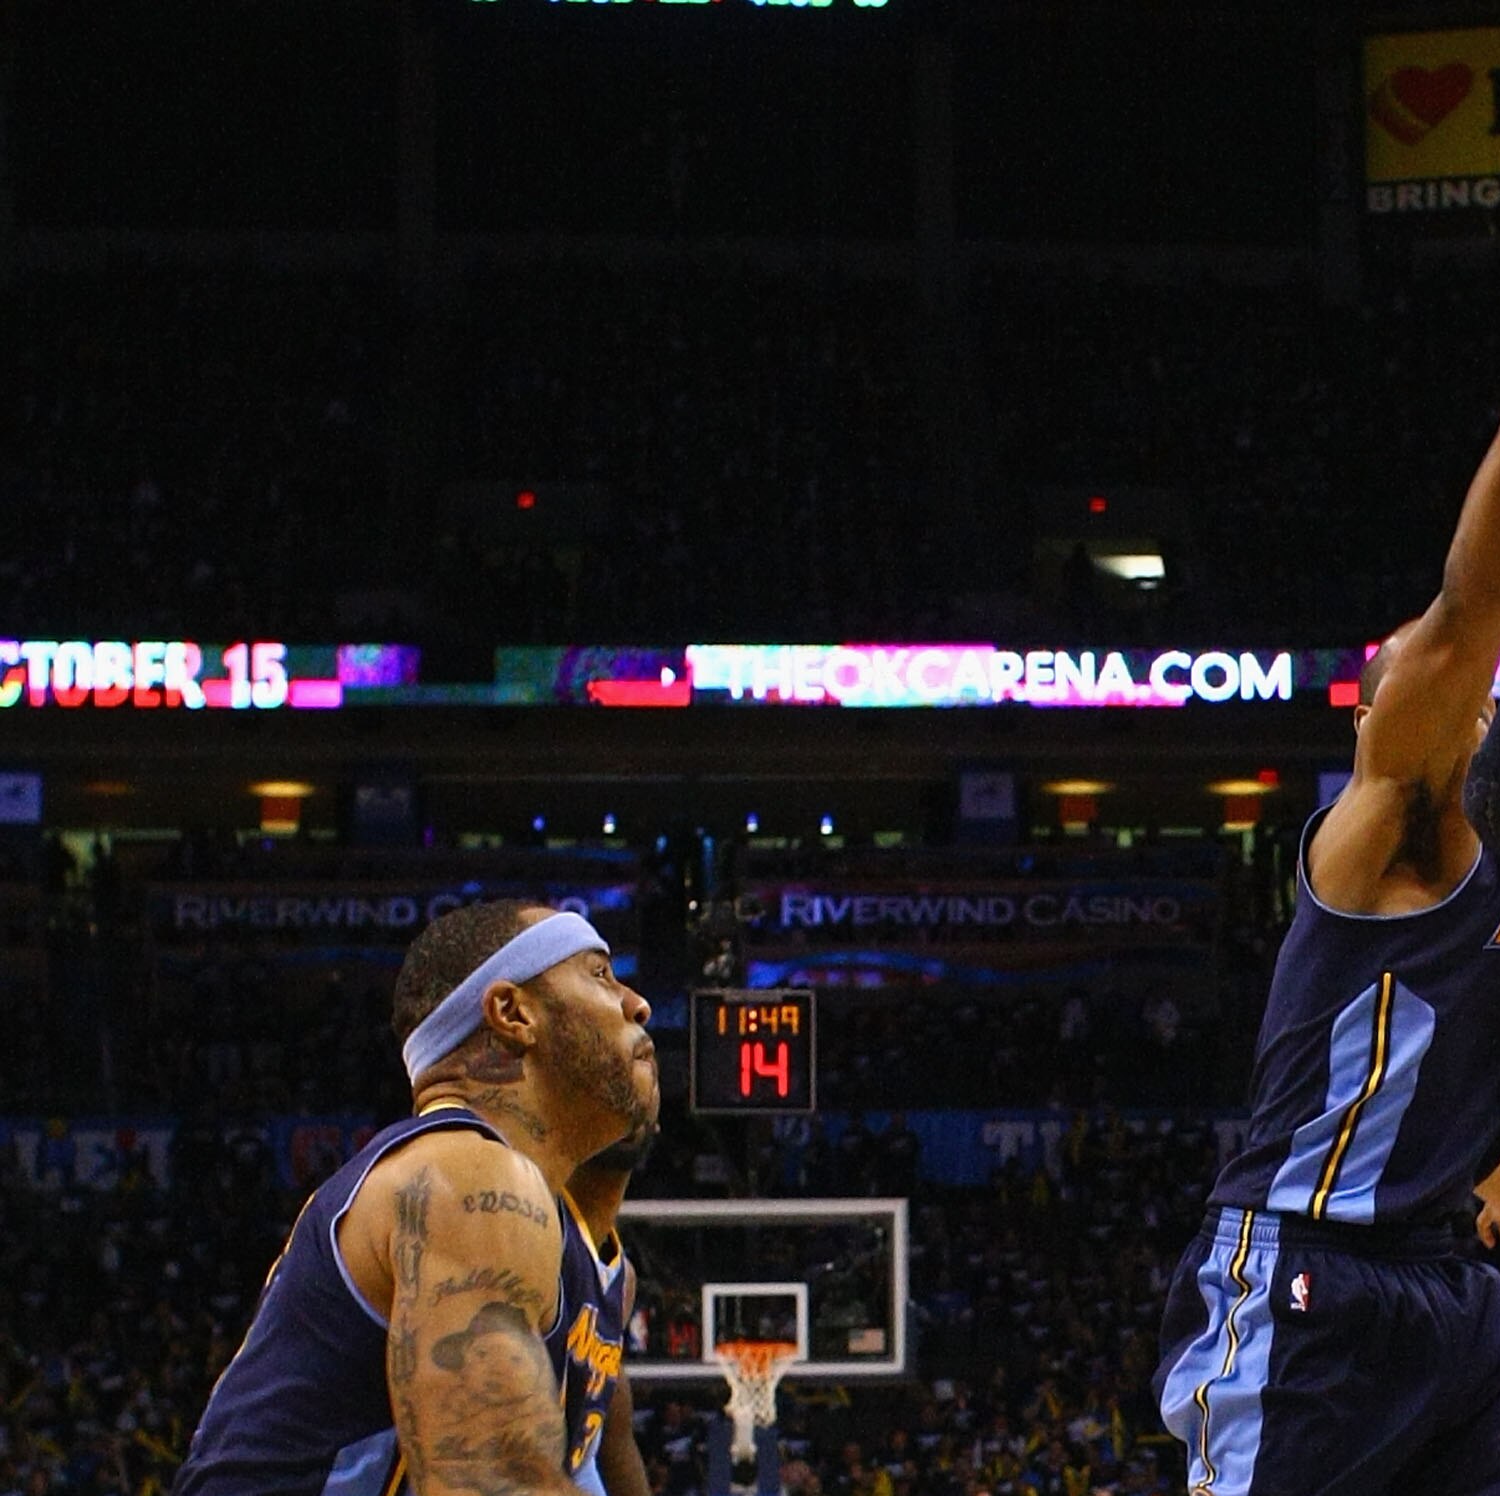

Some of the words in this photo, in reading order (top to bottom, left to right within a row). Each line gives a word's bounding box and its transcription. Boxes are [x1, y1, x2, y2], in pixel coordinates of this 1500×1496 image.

[223, 643, 289, 709] 15
[728, 650, 1293, 701] THEOKCARENA.COM
[174, 896, 418, 927] RIVERWIND
[781, 895, 1013, 927] RIVERWIND
[1025, 894, 1181, 925] CASINO
[718, 1005, 799, 1036] 11:49
[741, 1041, 788, 1098] 14
